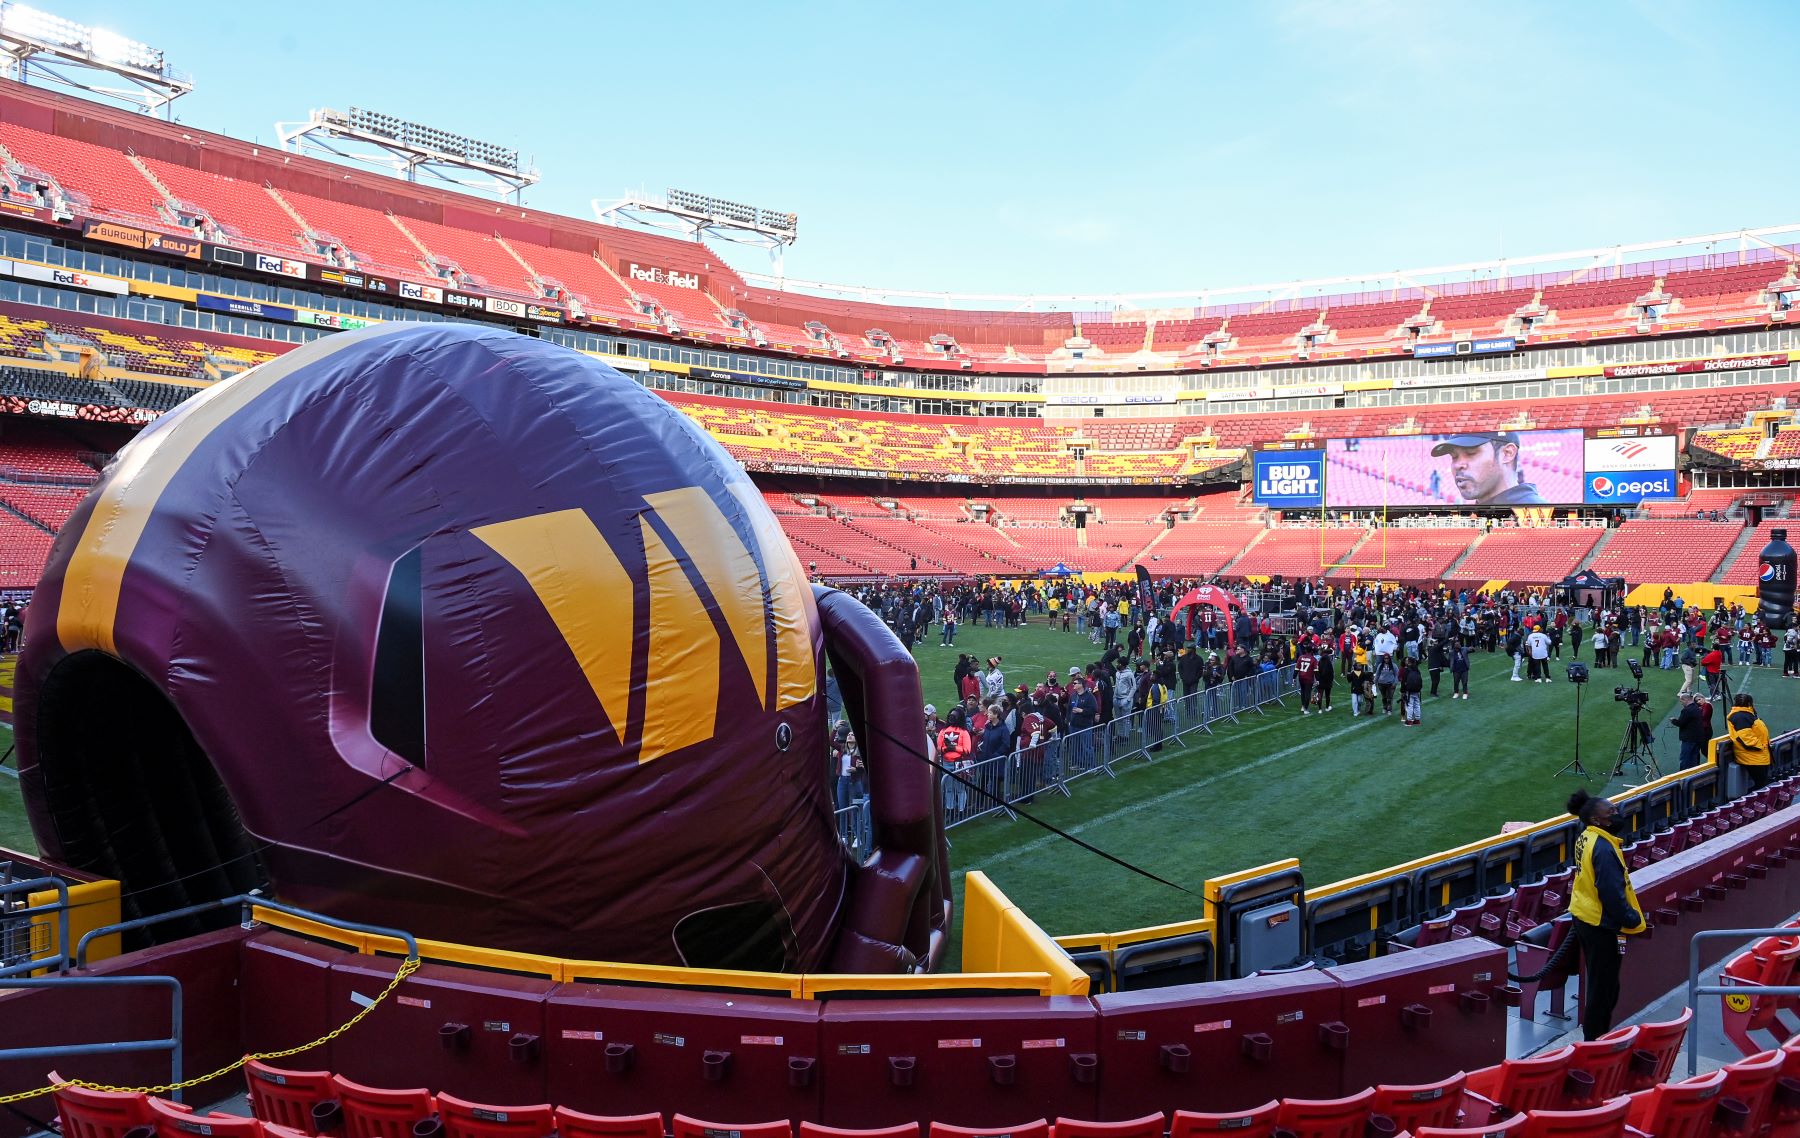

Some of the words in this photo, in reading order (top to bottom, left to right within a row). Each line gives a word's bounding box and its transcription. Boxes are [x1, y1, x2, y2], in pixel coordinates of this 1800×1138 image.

[101, 228, 152, 244] BURGUNDY
[153, 238, 161, 247] &
[162, 240, 187, 251] GOLD
[260, 256, 299, 276] FedEx
[53, 270, 88, 286] FedEx
[630, 263, 698, 290] FedExField
[402, 283, 436, 301] FedEx
[469, 298, 482, 308] PM
[496, 300, 518, 312] BDO
[539, 307, 561, 318] Sports
[1614, 366, 1679, 376] ticketmaster
[1704, 357, 1774, 370] ticketmaster
[1125, 395, 1162, 403] GEICO
[1269, 465, 1310, 480] BUD
[1261, 480, 1318, 495] LIGHT
[1617, 478, 1668, 497] pepsi
[1300, 662, 1310, 672] 17
